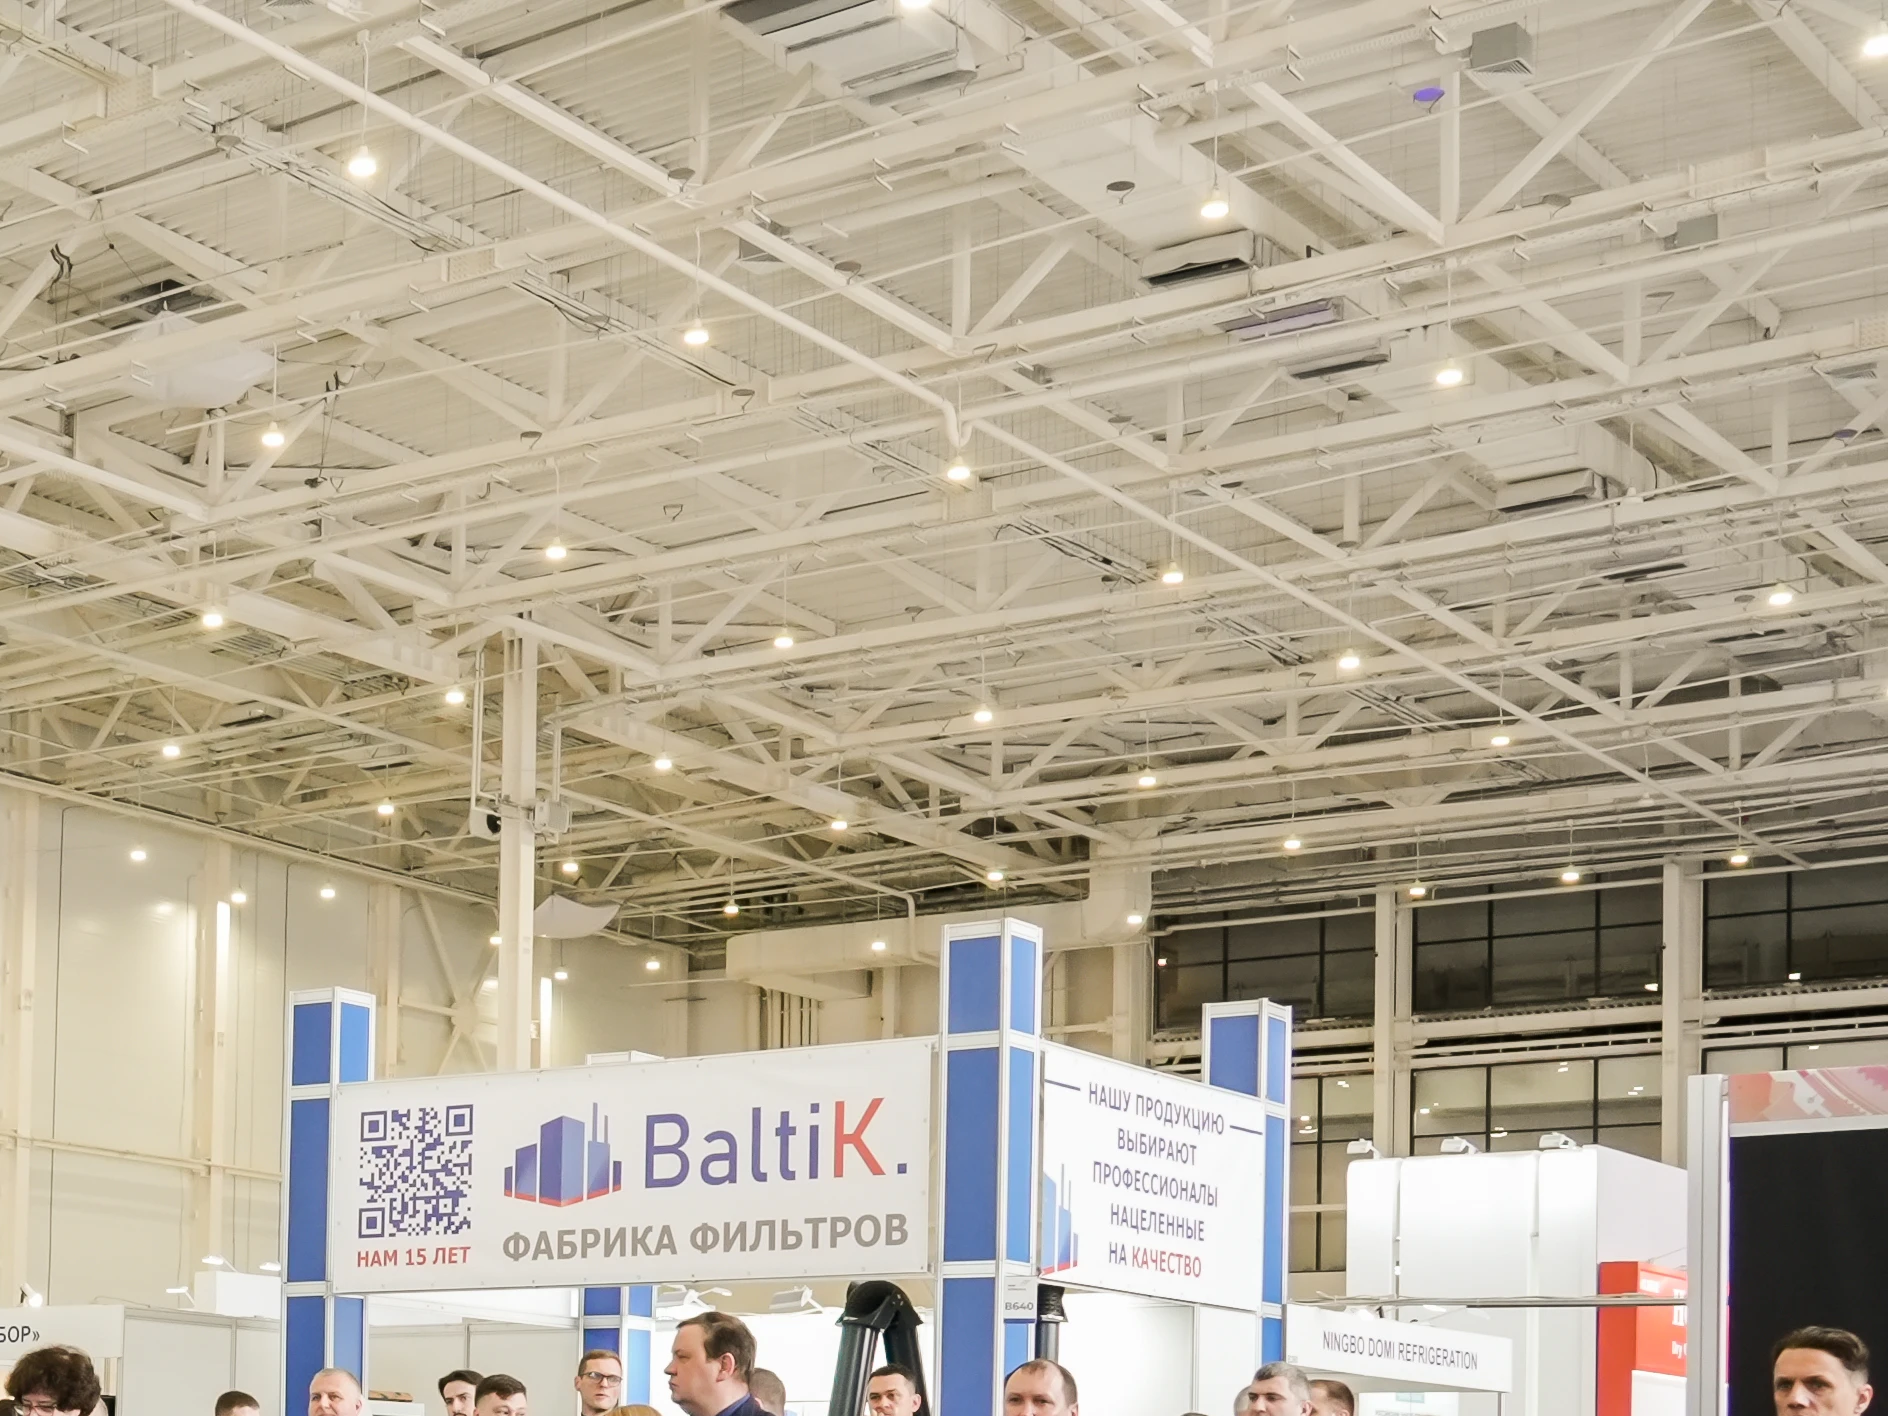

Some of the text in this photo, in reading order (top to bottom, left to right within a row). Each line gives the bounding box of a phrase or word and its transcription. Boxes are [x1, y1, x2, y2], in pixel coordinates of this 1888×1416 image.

[1088, 1082, 1225, 1135] НАШУ ПРОДУКЦИЮ
[1117, 1128, 1197, 1166] ВЫБИРАЮТ
[1093, 1160, 1218, 1208] ПРОФЕССИОНАЛЫ
[502, 1213, 909, 1263] ФАБРИКА ФИЛЬТРОВ
[1110, 1203, 1205, 1242] НАЦЕЛЕННЫЕ
[357, 1246, 472, 1268] НАМ 15 ЛЕТ
[1108, 1242, 1202, 1278] НА КАЧЕСТВО
[1005, 1302, 1034, 1311] B640
[1323, 1330, 1479, 1370] NINGBO DOMI REFRIGERATION
